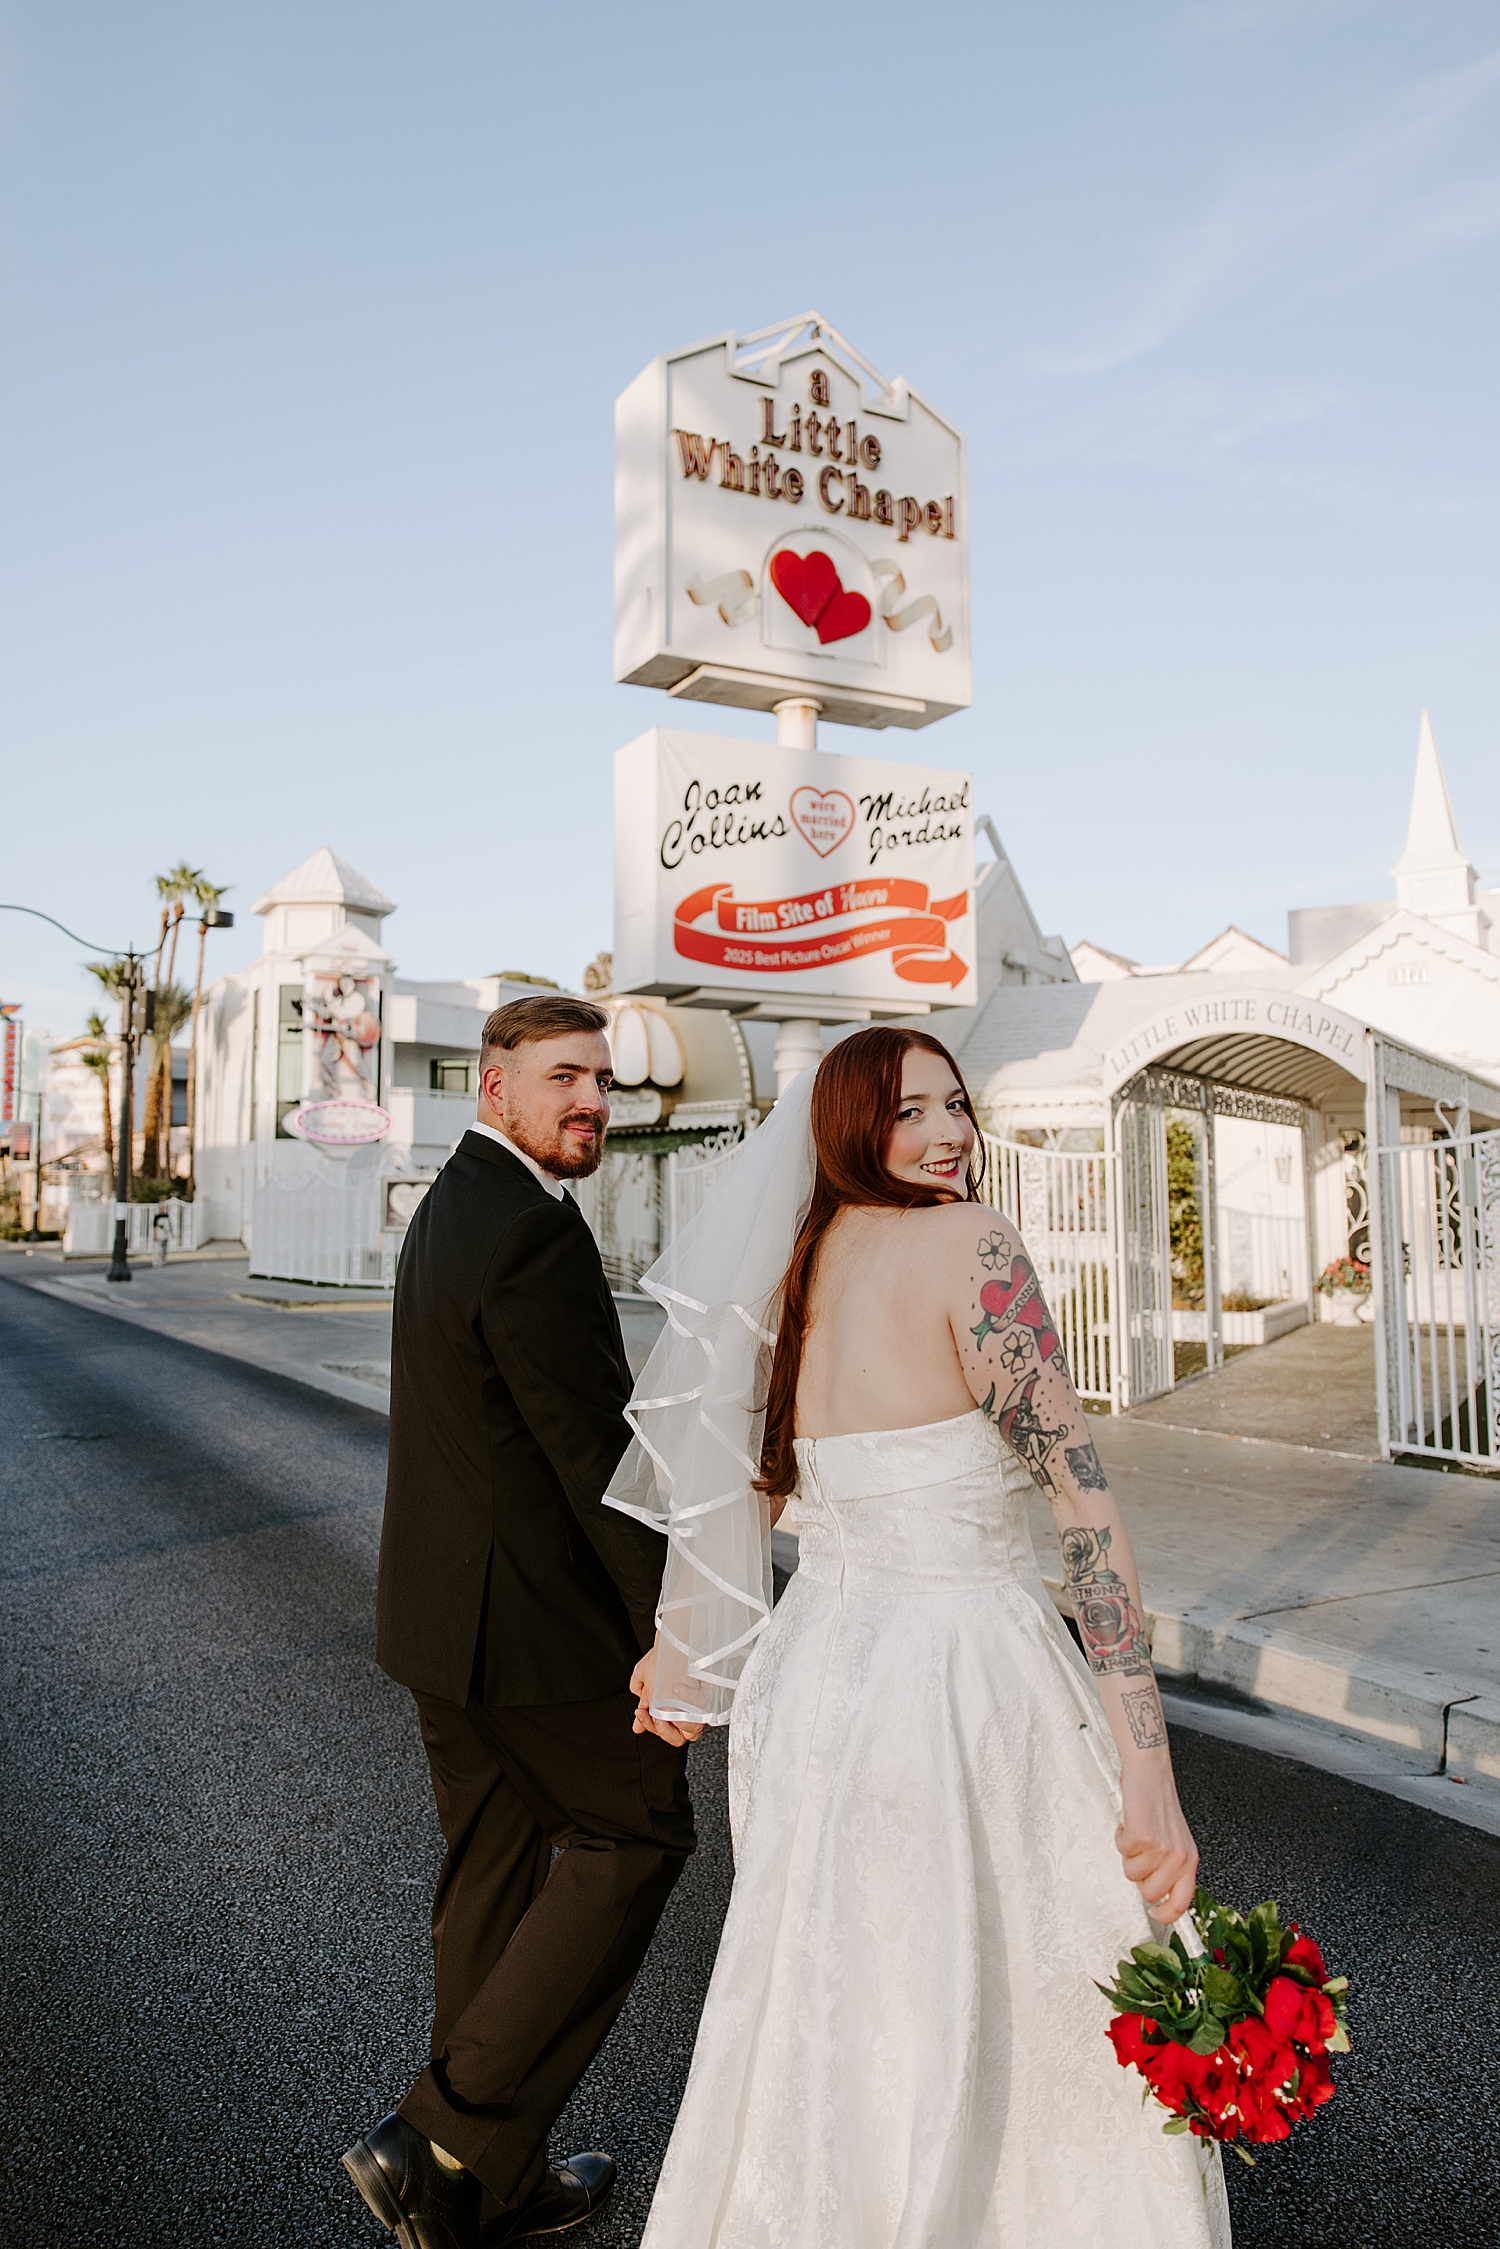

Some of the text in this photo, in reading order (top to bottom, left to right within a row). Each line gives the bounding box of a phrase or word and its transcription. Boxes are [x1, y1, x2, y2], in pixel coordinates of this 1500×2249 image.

[811, 368, 830, 407] a
[759, 396, 882, 470] Little
[672, 428, 955, 542] White Chapel
[684, 780, 763, 831] Joan
[801, 813, 846, 828] married
[859, 781, 969, 821] Michael
[660, 812, 789, 869] Collins
[811, 827, 835, 840] here
[869, 819, 961, 864] Jordan
[735, 906, 778, 931] Film
[778, 901, 815, 928] Site
[814, 891, 835, 917] of
[723, 928, 891, 966] 2025 Best Picture Oscar Winner
[1111, 999, 1354, 1073] LITTLE WHITE CHAPEL
[1003, 1276, 1037, 1323] DANNY
